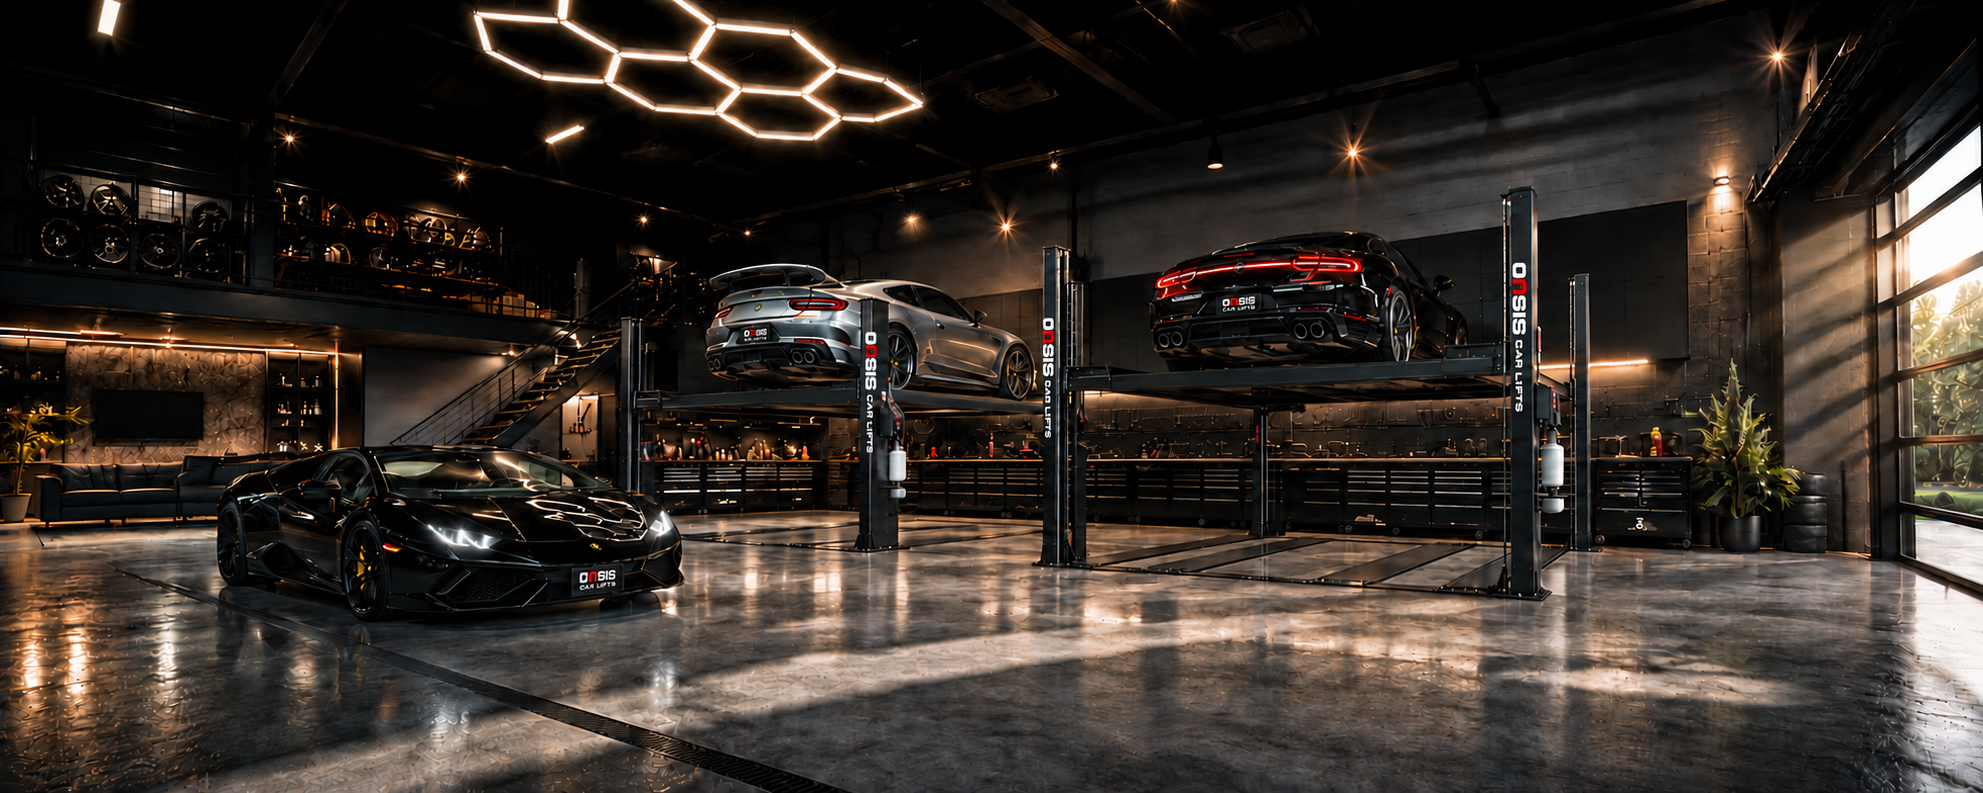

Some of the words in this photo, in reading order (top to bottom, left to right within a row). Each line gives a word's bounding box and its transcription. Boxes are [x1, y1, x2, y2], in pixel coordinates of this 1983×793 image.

[1514, 339, 1523, 368] CAR
[866, 394, 874, 419] CAR
[1514, 372, 1523, 412] LIFTS
[866, 420, 874, 453] LIFTS
[1044, 406, 1052, 439] LIFTS
[579, 583, 595, 591] CAR
